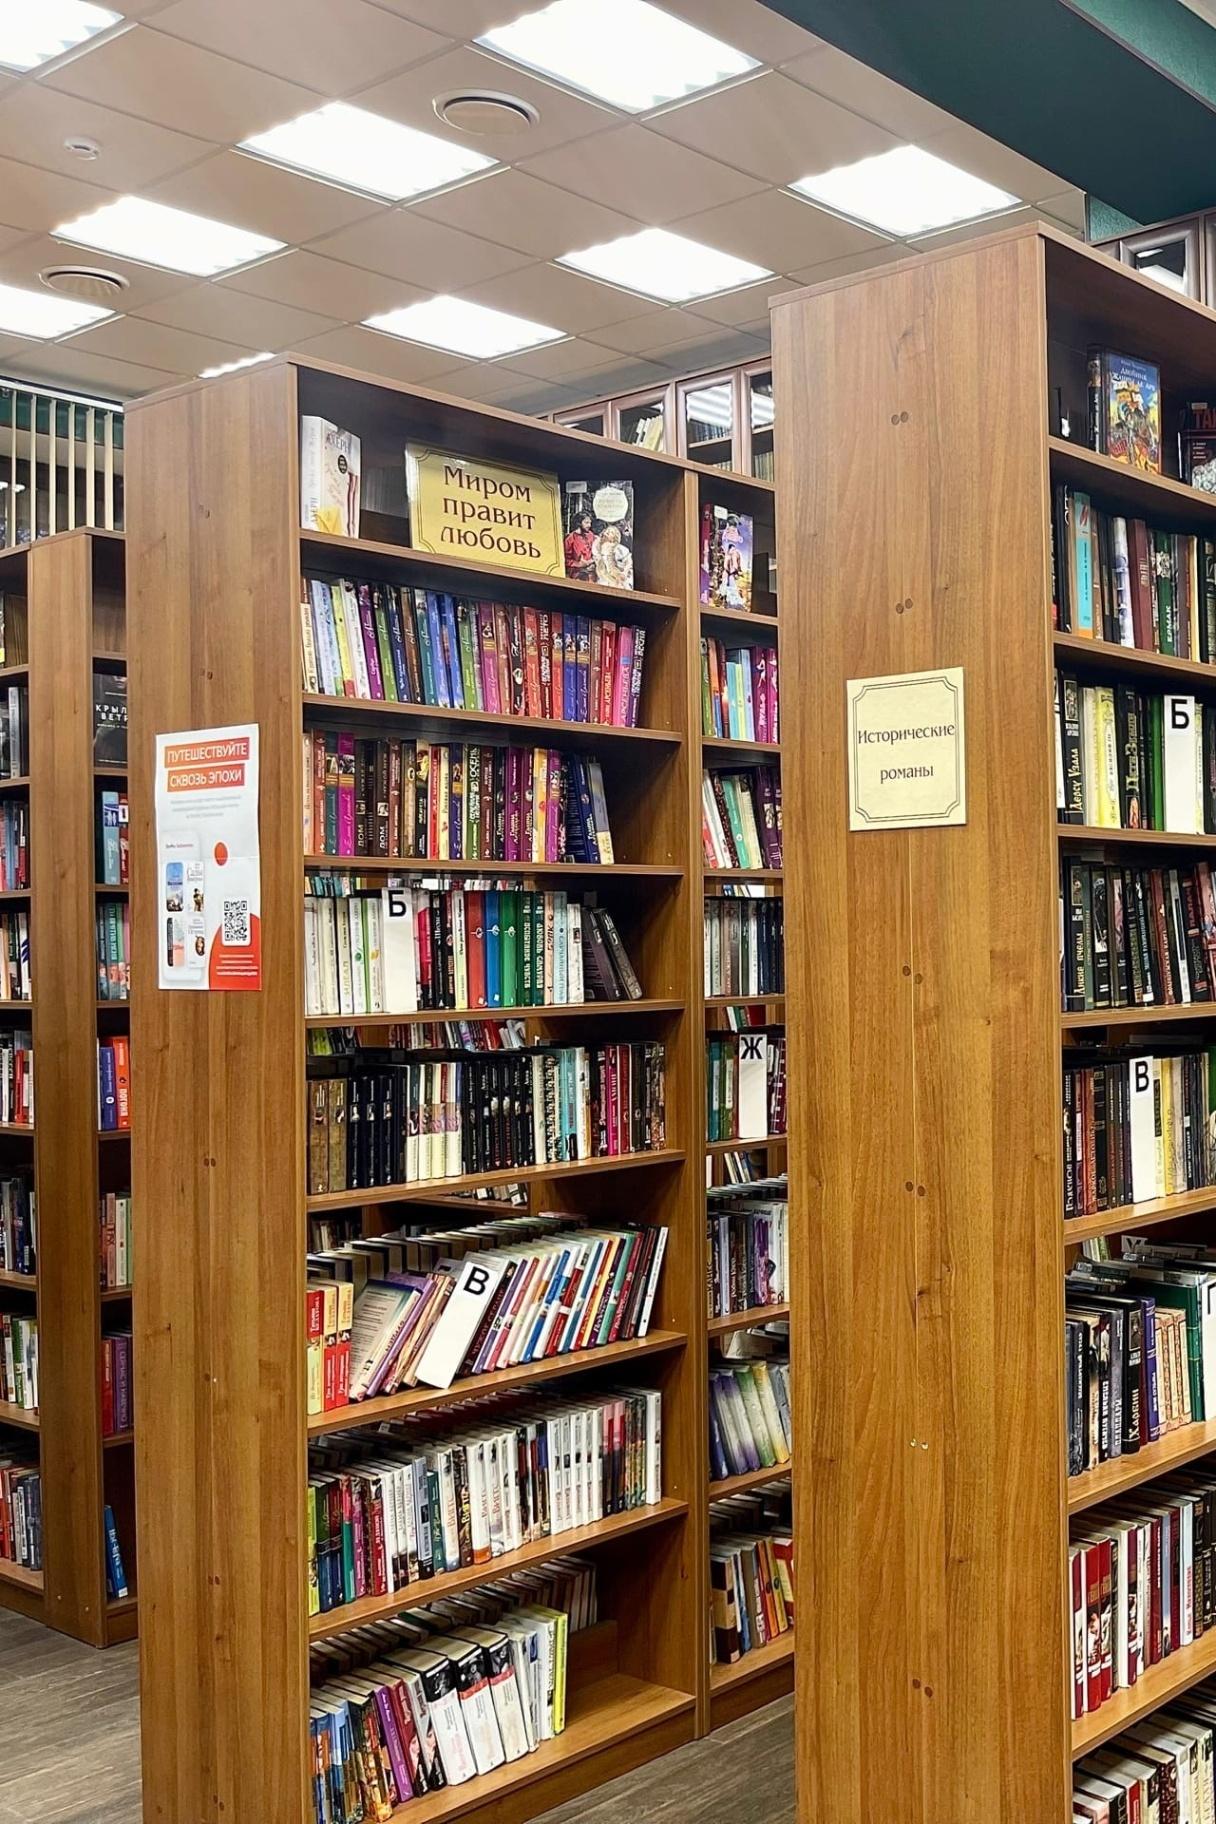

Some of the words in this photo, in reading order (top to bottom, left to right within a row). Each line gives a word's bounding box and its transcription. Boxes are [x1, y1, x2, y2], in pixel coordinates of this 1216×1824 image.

[444, 466, 532, 503] Миром
[443, 497, 536, 530] правит
[440, 525, 541, 559] любовь
[1171, 699, 1190, 729] Б
[858, 724, 955, 745] Исторические
[167, 743, 248, 763] ПУТЕШЕСТВУЙТЕ
[1068, 748, 1082, 778] Узала
[170, 769, 207, 787] СКВОЗЬ
[208, 768, 242, 785] ЭПОХИ
[880, 766, 934, 784] романы
[1069, 779, 1083, 812] Дерсу
[388, 890, 407, 917] Б
[741, 1036, 763, 1060] Ж
[1135, 1061, 1150, 1093] В
[464, 1266, 489, 1296] В
[1207, 1282, 1216, 1315] Г
